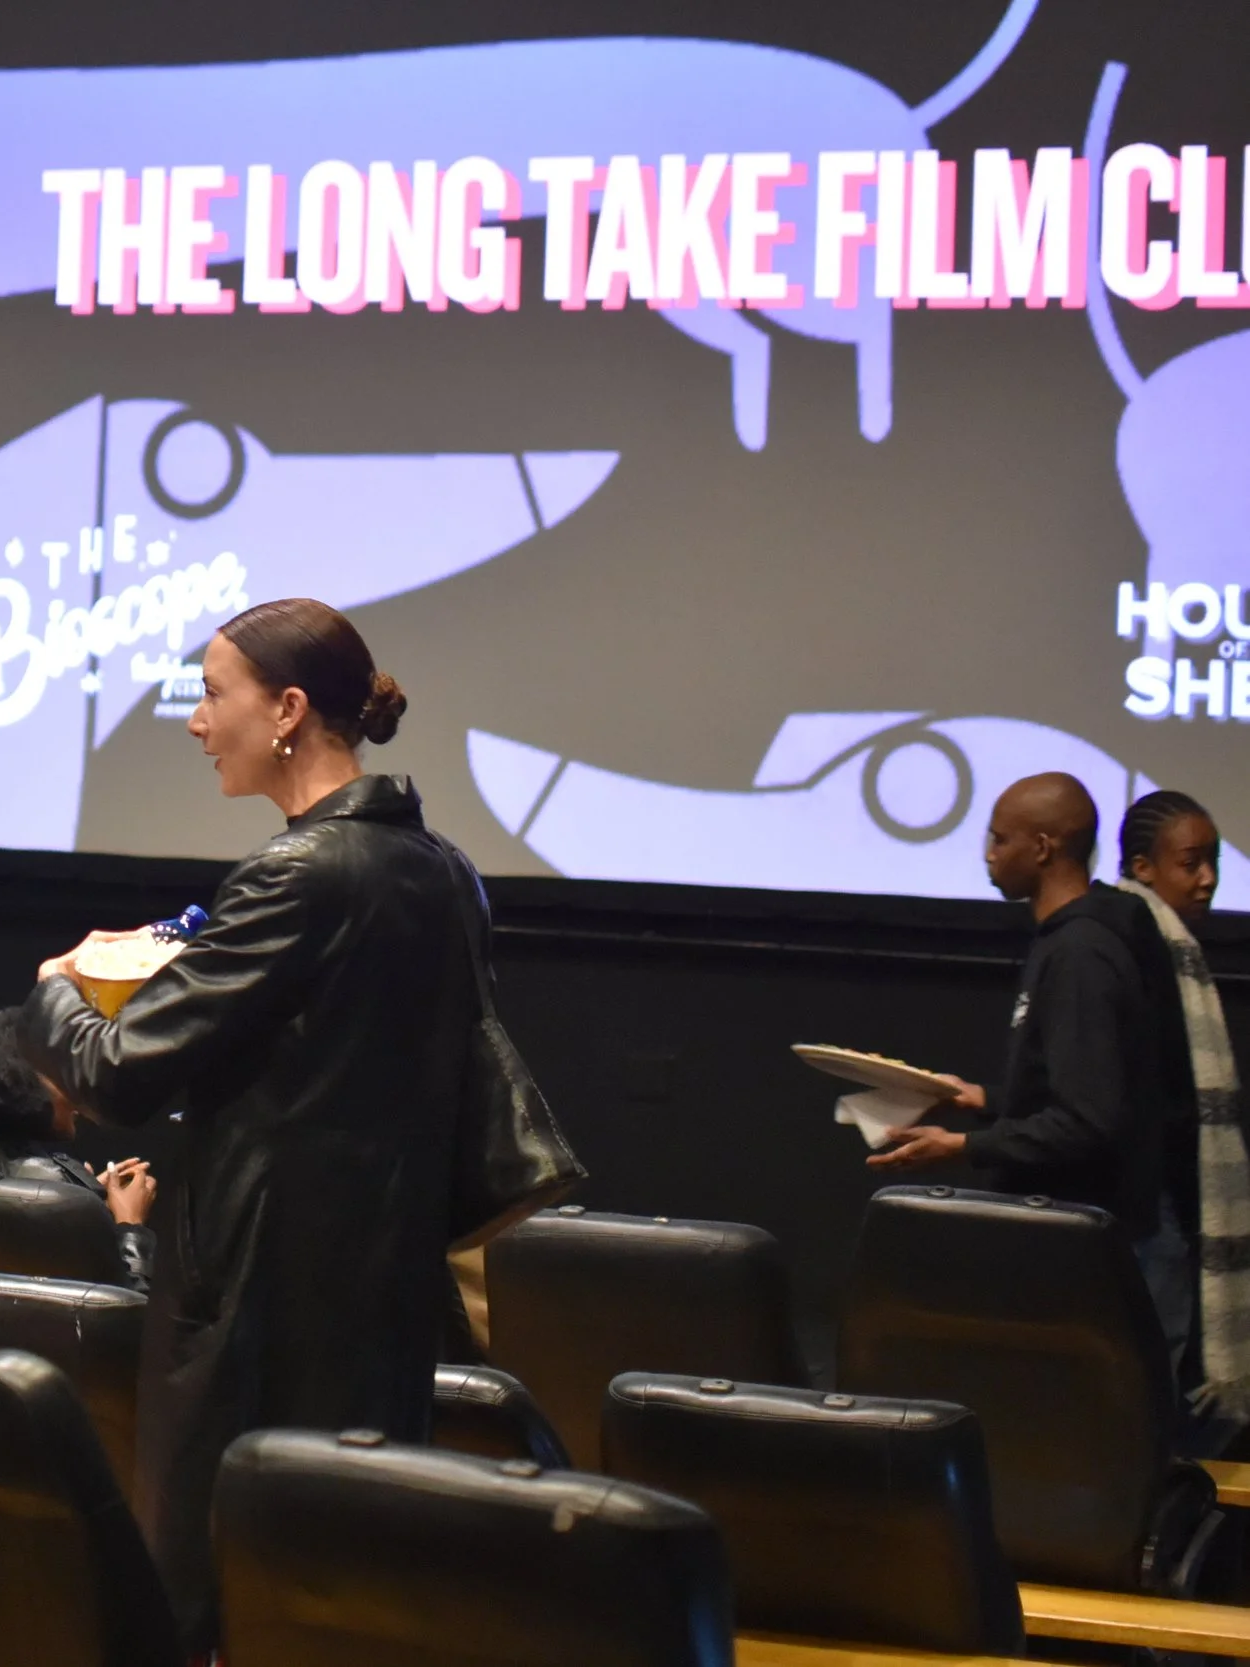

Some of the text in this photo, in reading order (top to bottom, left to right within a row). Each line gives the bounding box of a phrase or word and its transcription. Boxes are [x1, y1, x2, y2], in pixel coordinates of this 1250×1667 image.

[42, 143, 1250, 310] THE LONG TAKE FILM CL
[41, 514, 138, 590] THE
